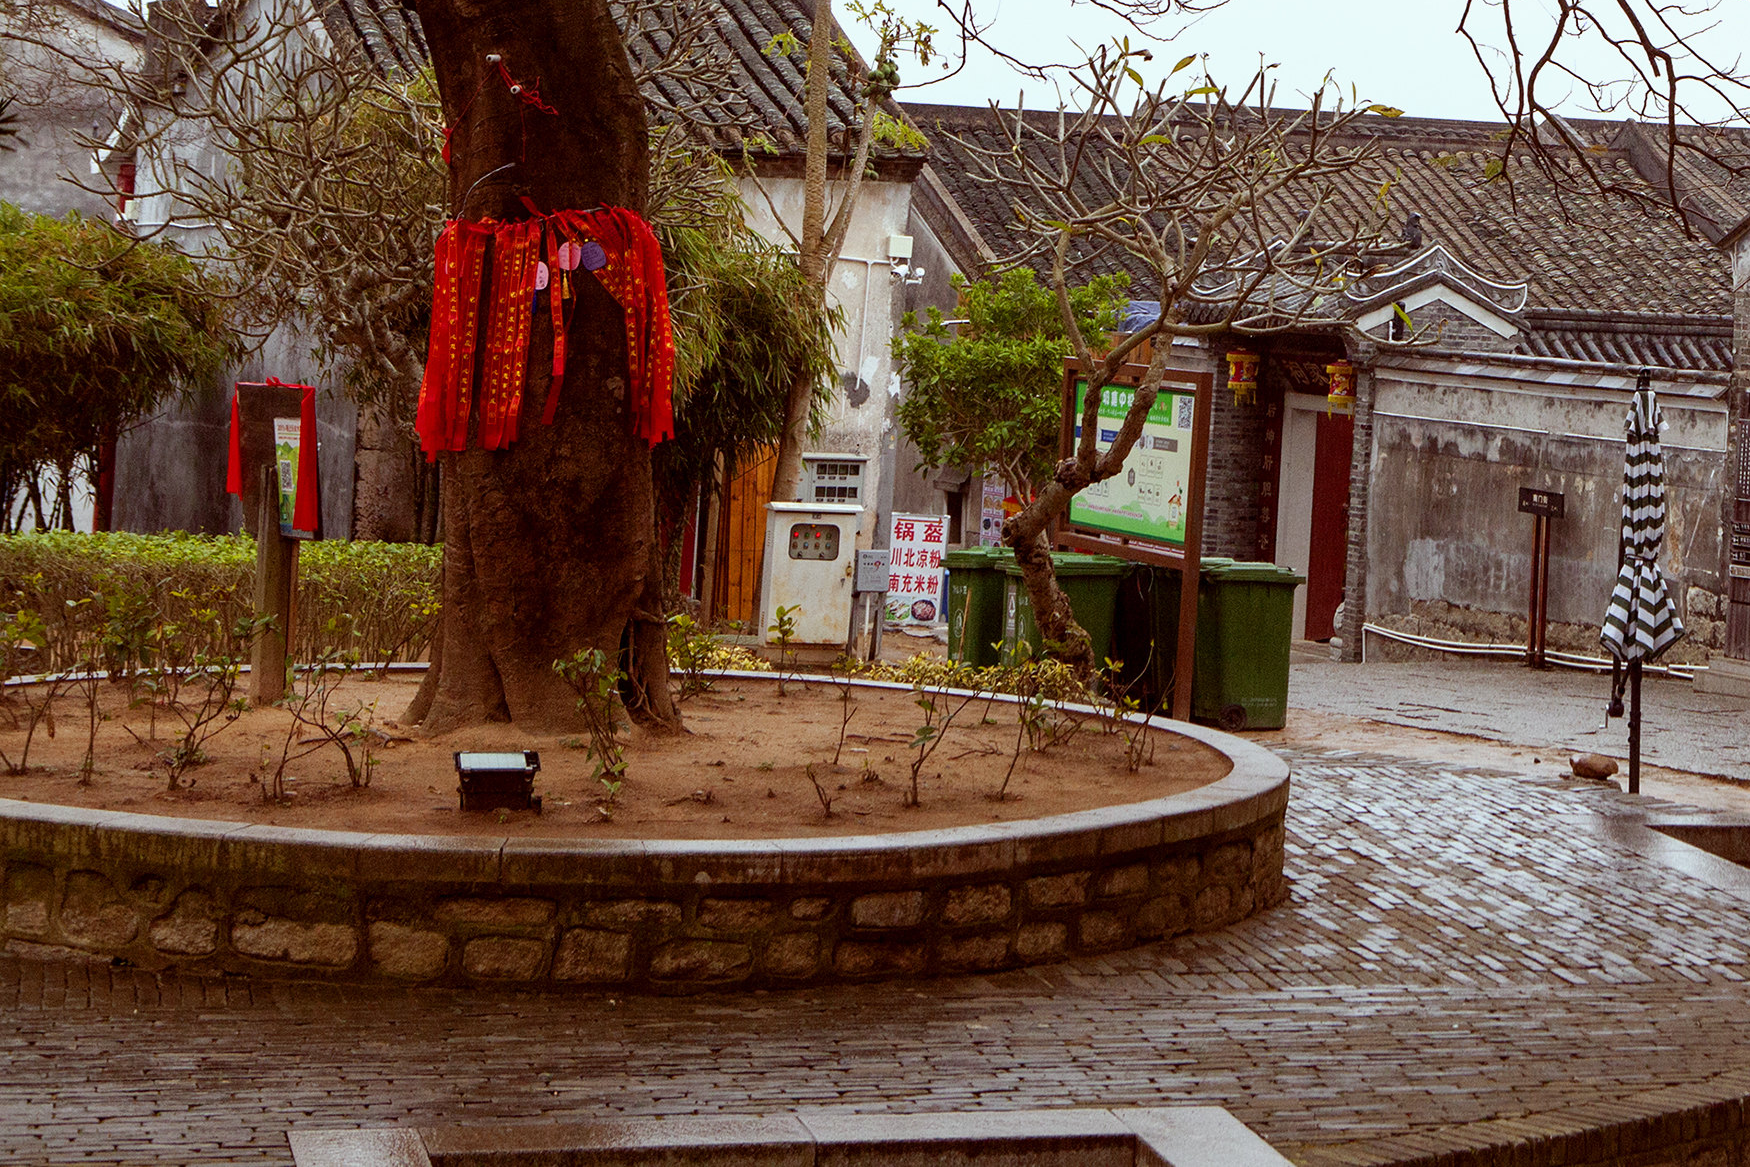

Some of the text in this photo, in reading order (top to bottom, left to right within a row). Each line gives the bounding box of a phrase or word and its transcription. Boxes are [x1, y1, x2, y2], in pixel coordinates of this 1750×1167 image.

[894, 522, 944, 543] 锅盔
[890, 548, 941, 569] 川北凉粉
[888, 572, 939, 595] 南充米粉
